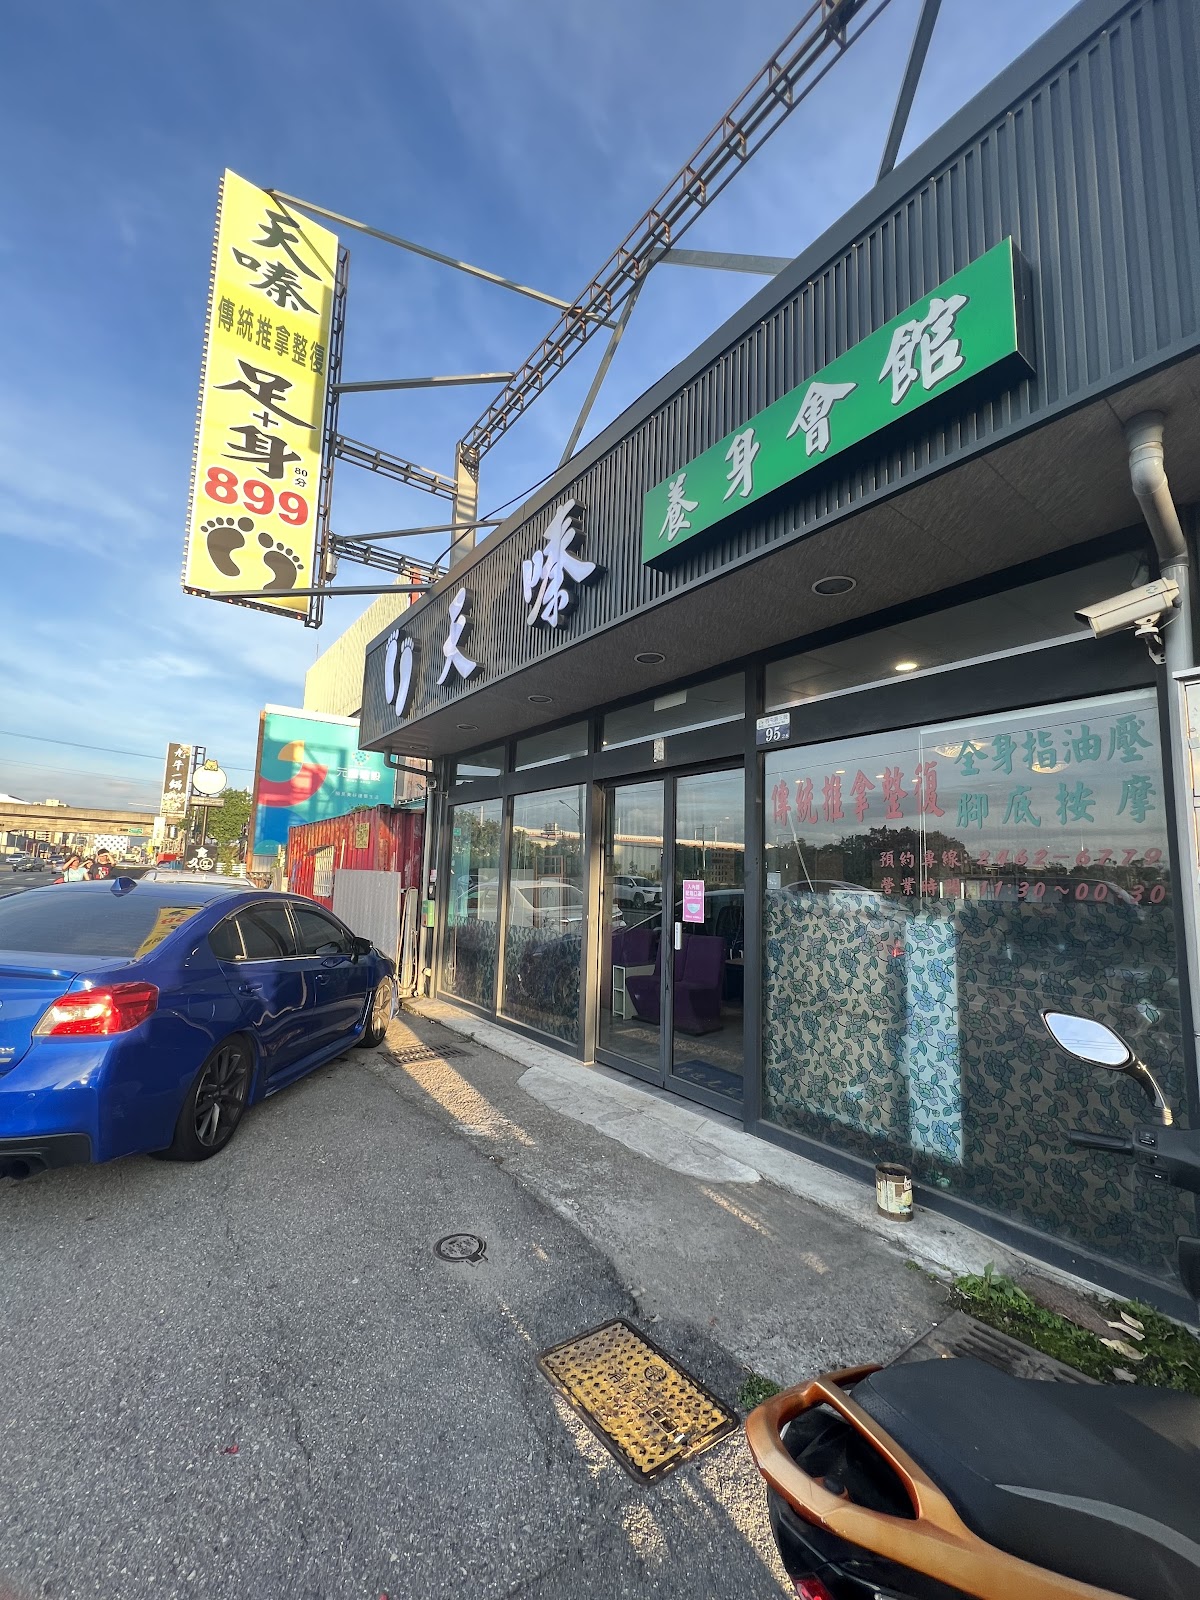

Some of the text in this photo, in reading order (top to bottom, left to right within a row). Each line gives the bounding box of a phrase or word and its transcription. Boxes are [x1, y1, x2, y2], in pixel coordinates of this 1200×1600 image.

[218, 295, 325, 377] 傳統推拿整復
[658, 293, 970, 543] 養身會館
[204, 466, 309, 526] 899
[294, 466, 308, 478] 80
[765, 726, 781, 742] 95
[954, 714, 1153, 777] 全身指油壓
[771, 761, 945, 827] 傳統推拿整復
[956, 774, 1157, 830] 腳底按摩
